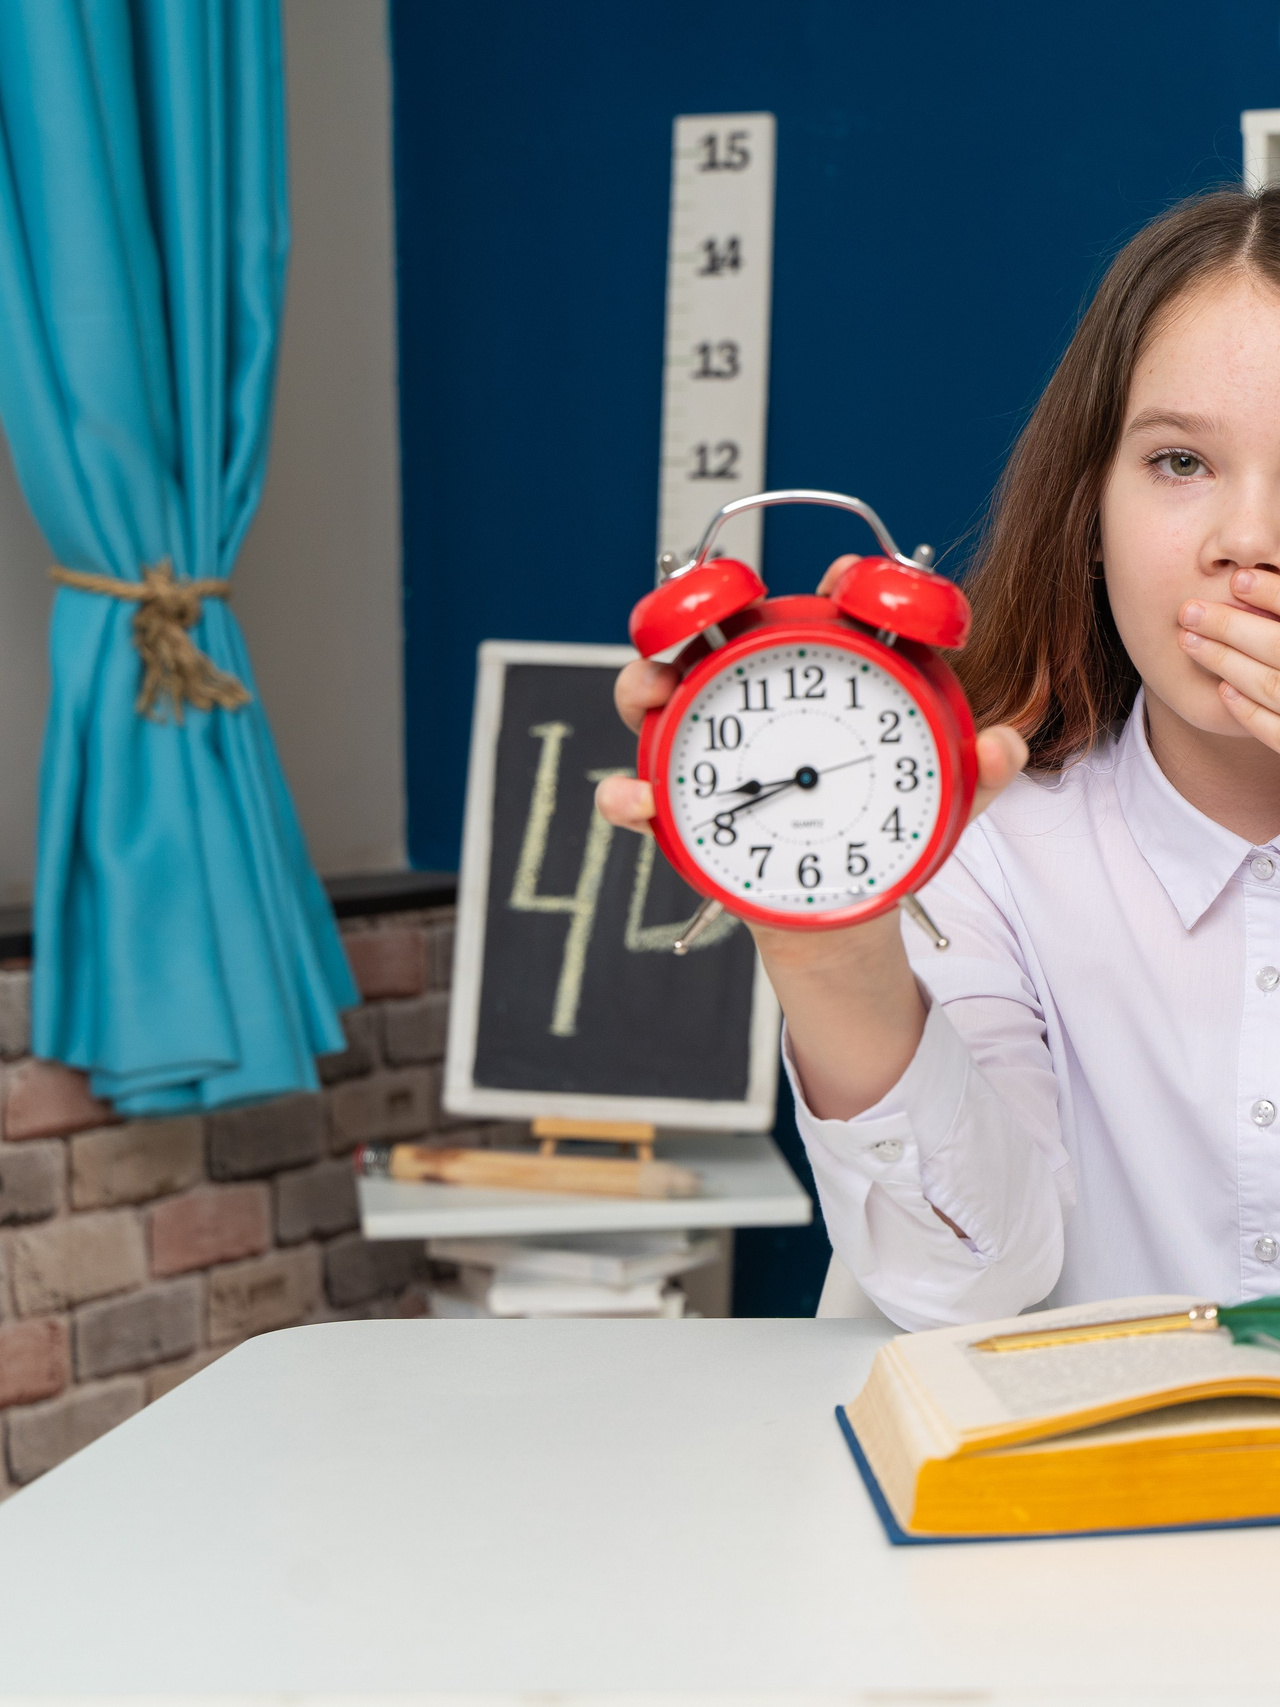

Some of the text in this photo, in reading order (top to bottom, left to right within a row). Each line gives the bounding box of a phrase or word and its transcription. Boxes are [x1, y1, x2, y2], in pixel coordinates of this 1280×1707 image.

[699, 131, 751, 173] 15
[699, 236, 742, 277] 14
[693, 340, 741, 381] 13
[689, 441, 740, 481] 12
[737, 679, 774, 712] 11
[783, 665, 826, 700] 12
[846, 676, 865, 709] 1
[704, 715, 743, 751] 10
[878, 710, 902, 744] 2
[692, 762, 719, 798] 9
[894, 757, 920, 792] 3
[711, 812, 739, 847] 8
[880, 806, 904, 842] 4
[748, 845, 774, 879] 7
[796, 854, 822, 889] 6
[846, 841, 870, 877] 5
